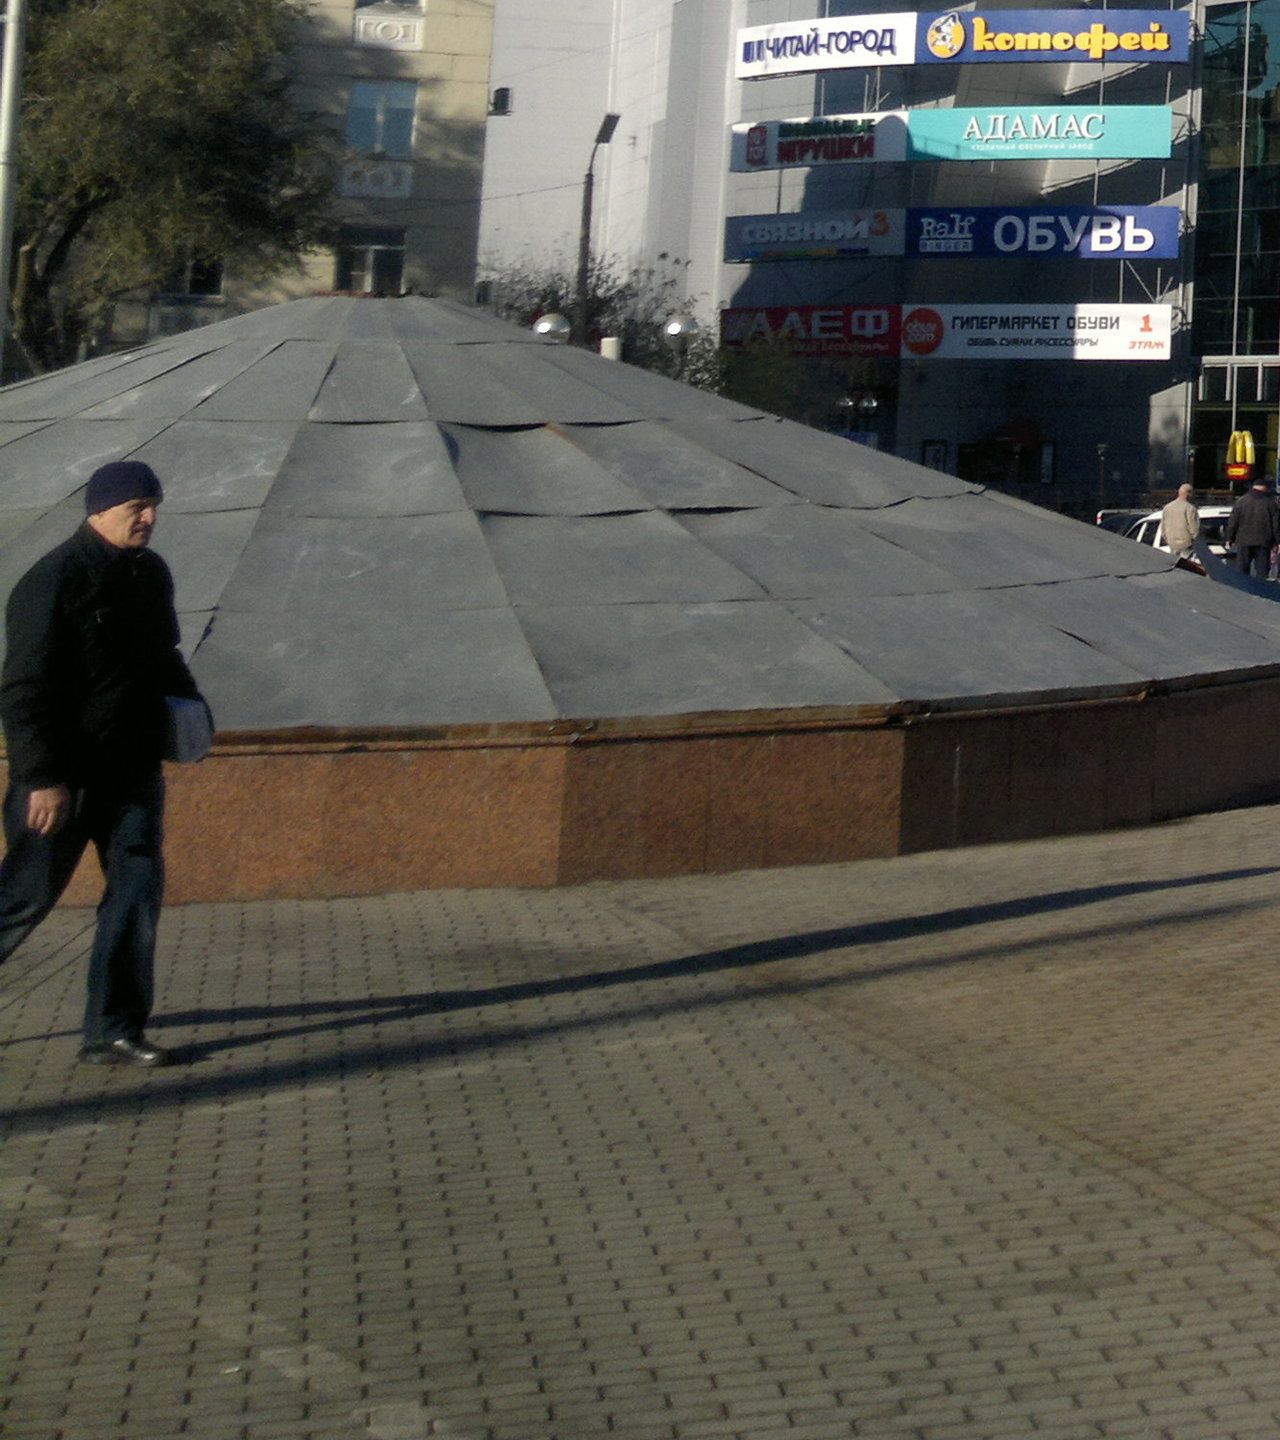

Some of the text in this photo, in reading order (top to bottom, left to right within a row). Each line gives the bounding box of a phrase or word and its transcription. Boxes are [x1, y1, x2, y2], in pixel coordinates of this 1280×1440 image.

[765, 28, 897, 60] ЧИТАЙ-ГОРОД
[972, 16, 1170, 60] котофей
[963, 113, 1106, 143] АДАМАС
[993, 215, 1155, 253] ОБУВЬ
[952, 315, 1120, 330] ГИПЕРМАРКЕТ ОБУВИ
[1139, 314, 1152, 332] 1
